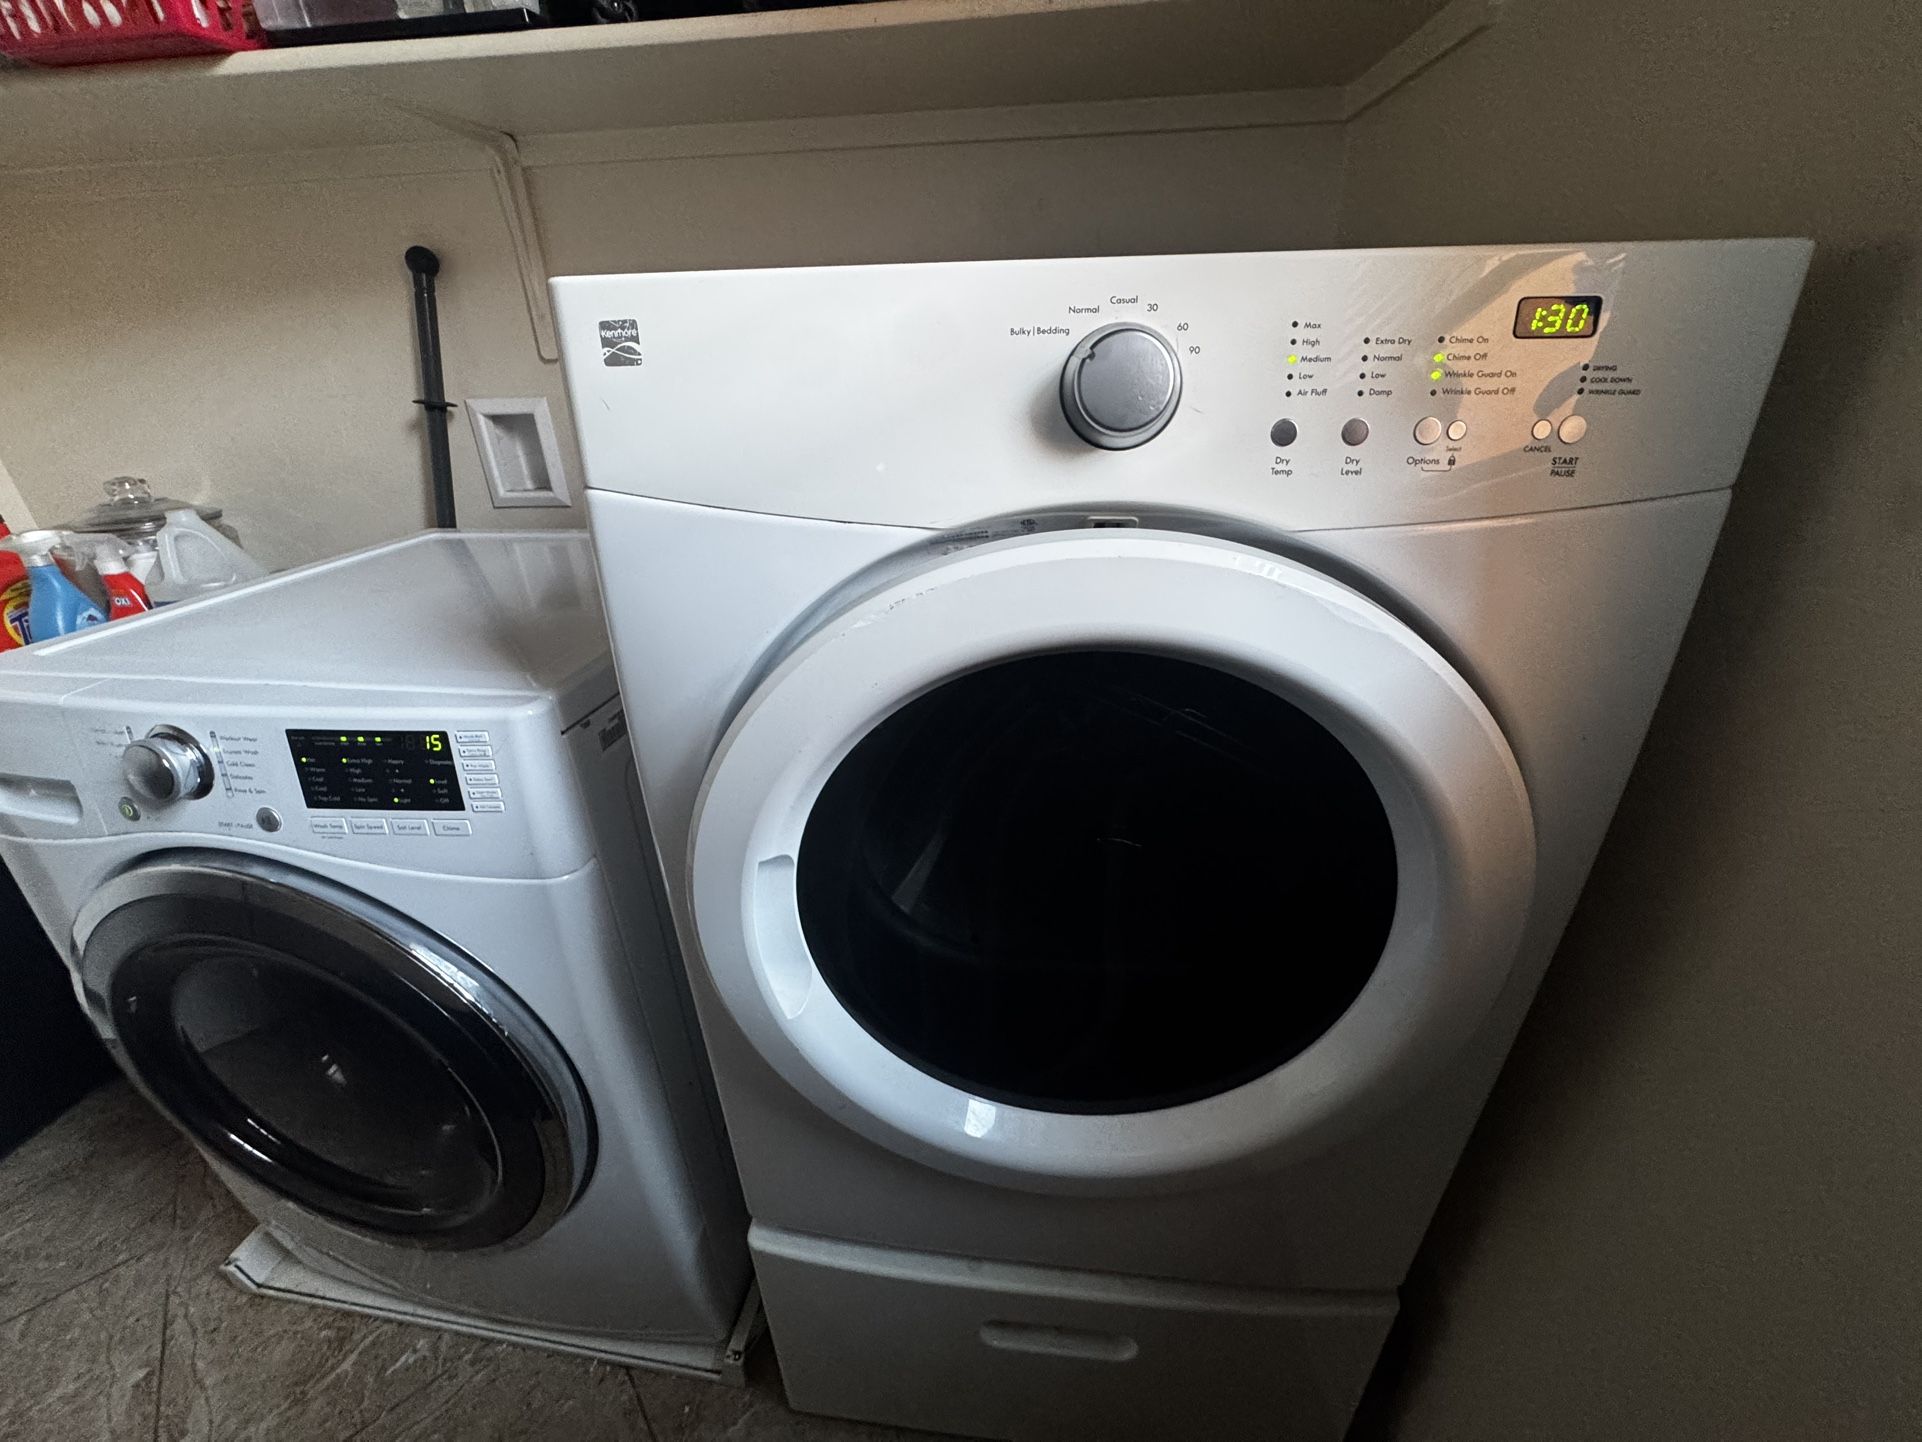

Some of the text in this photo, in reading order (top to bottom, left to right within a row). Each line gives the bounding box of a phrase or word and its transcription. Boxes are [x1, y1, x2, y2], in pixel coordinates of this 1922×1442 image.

[1110, 296, 1138, 304] Casual
[1068, 306, 1100, 314] Normal
[1146, 303, 1158, 312] 30
[1531, 304, 1589, 333] 1:30
[1176, 322, 1189, 332] 60
[601, 328, 638, 339] Kenmore
[1302, 338, 1320, 348] High
[1375, 337, 1412, 346] Extra Dry
[1449, 336, 1489, 344] Chime On
[1189, 346, 1200, 354] 90
[1300, 354, 1332, 362] Medium
[1372, 354, 1403, 362] Normal
[1474, 352, 1488, 360] Off
[1298, 372, 1314, 380] Low
[1370, 371, 1386, 379] Low
[1444, 370, 1517, 378] Wrinkle Guard On
[1310, 388, 1328, 396] Fluff
[1368, 388, 1392, 397] Damp
[1442, 387, 1516, 396] Wrinkle Guard Off
[1523, 445, 1552, 453] CANCEL
[1274, 456, 1290, 466] Dry
[1344, 456, 1360, 466] Dry
[1406, 456, 1440, 467] Options
[1551, 456, 1579, 466] START
[1271, 468, 1292, 478] Temp
[1340, 468, 1362, 476] Level
[1550, 469, 1576, 478] PAUSE
[426, 734, 442, 751] 15
